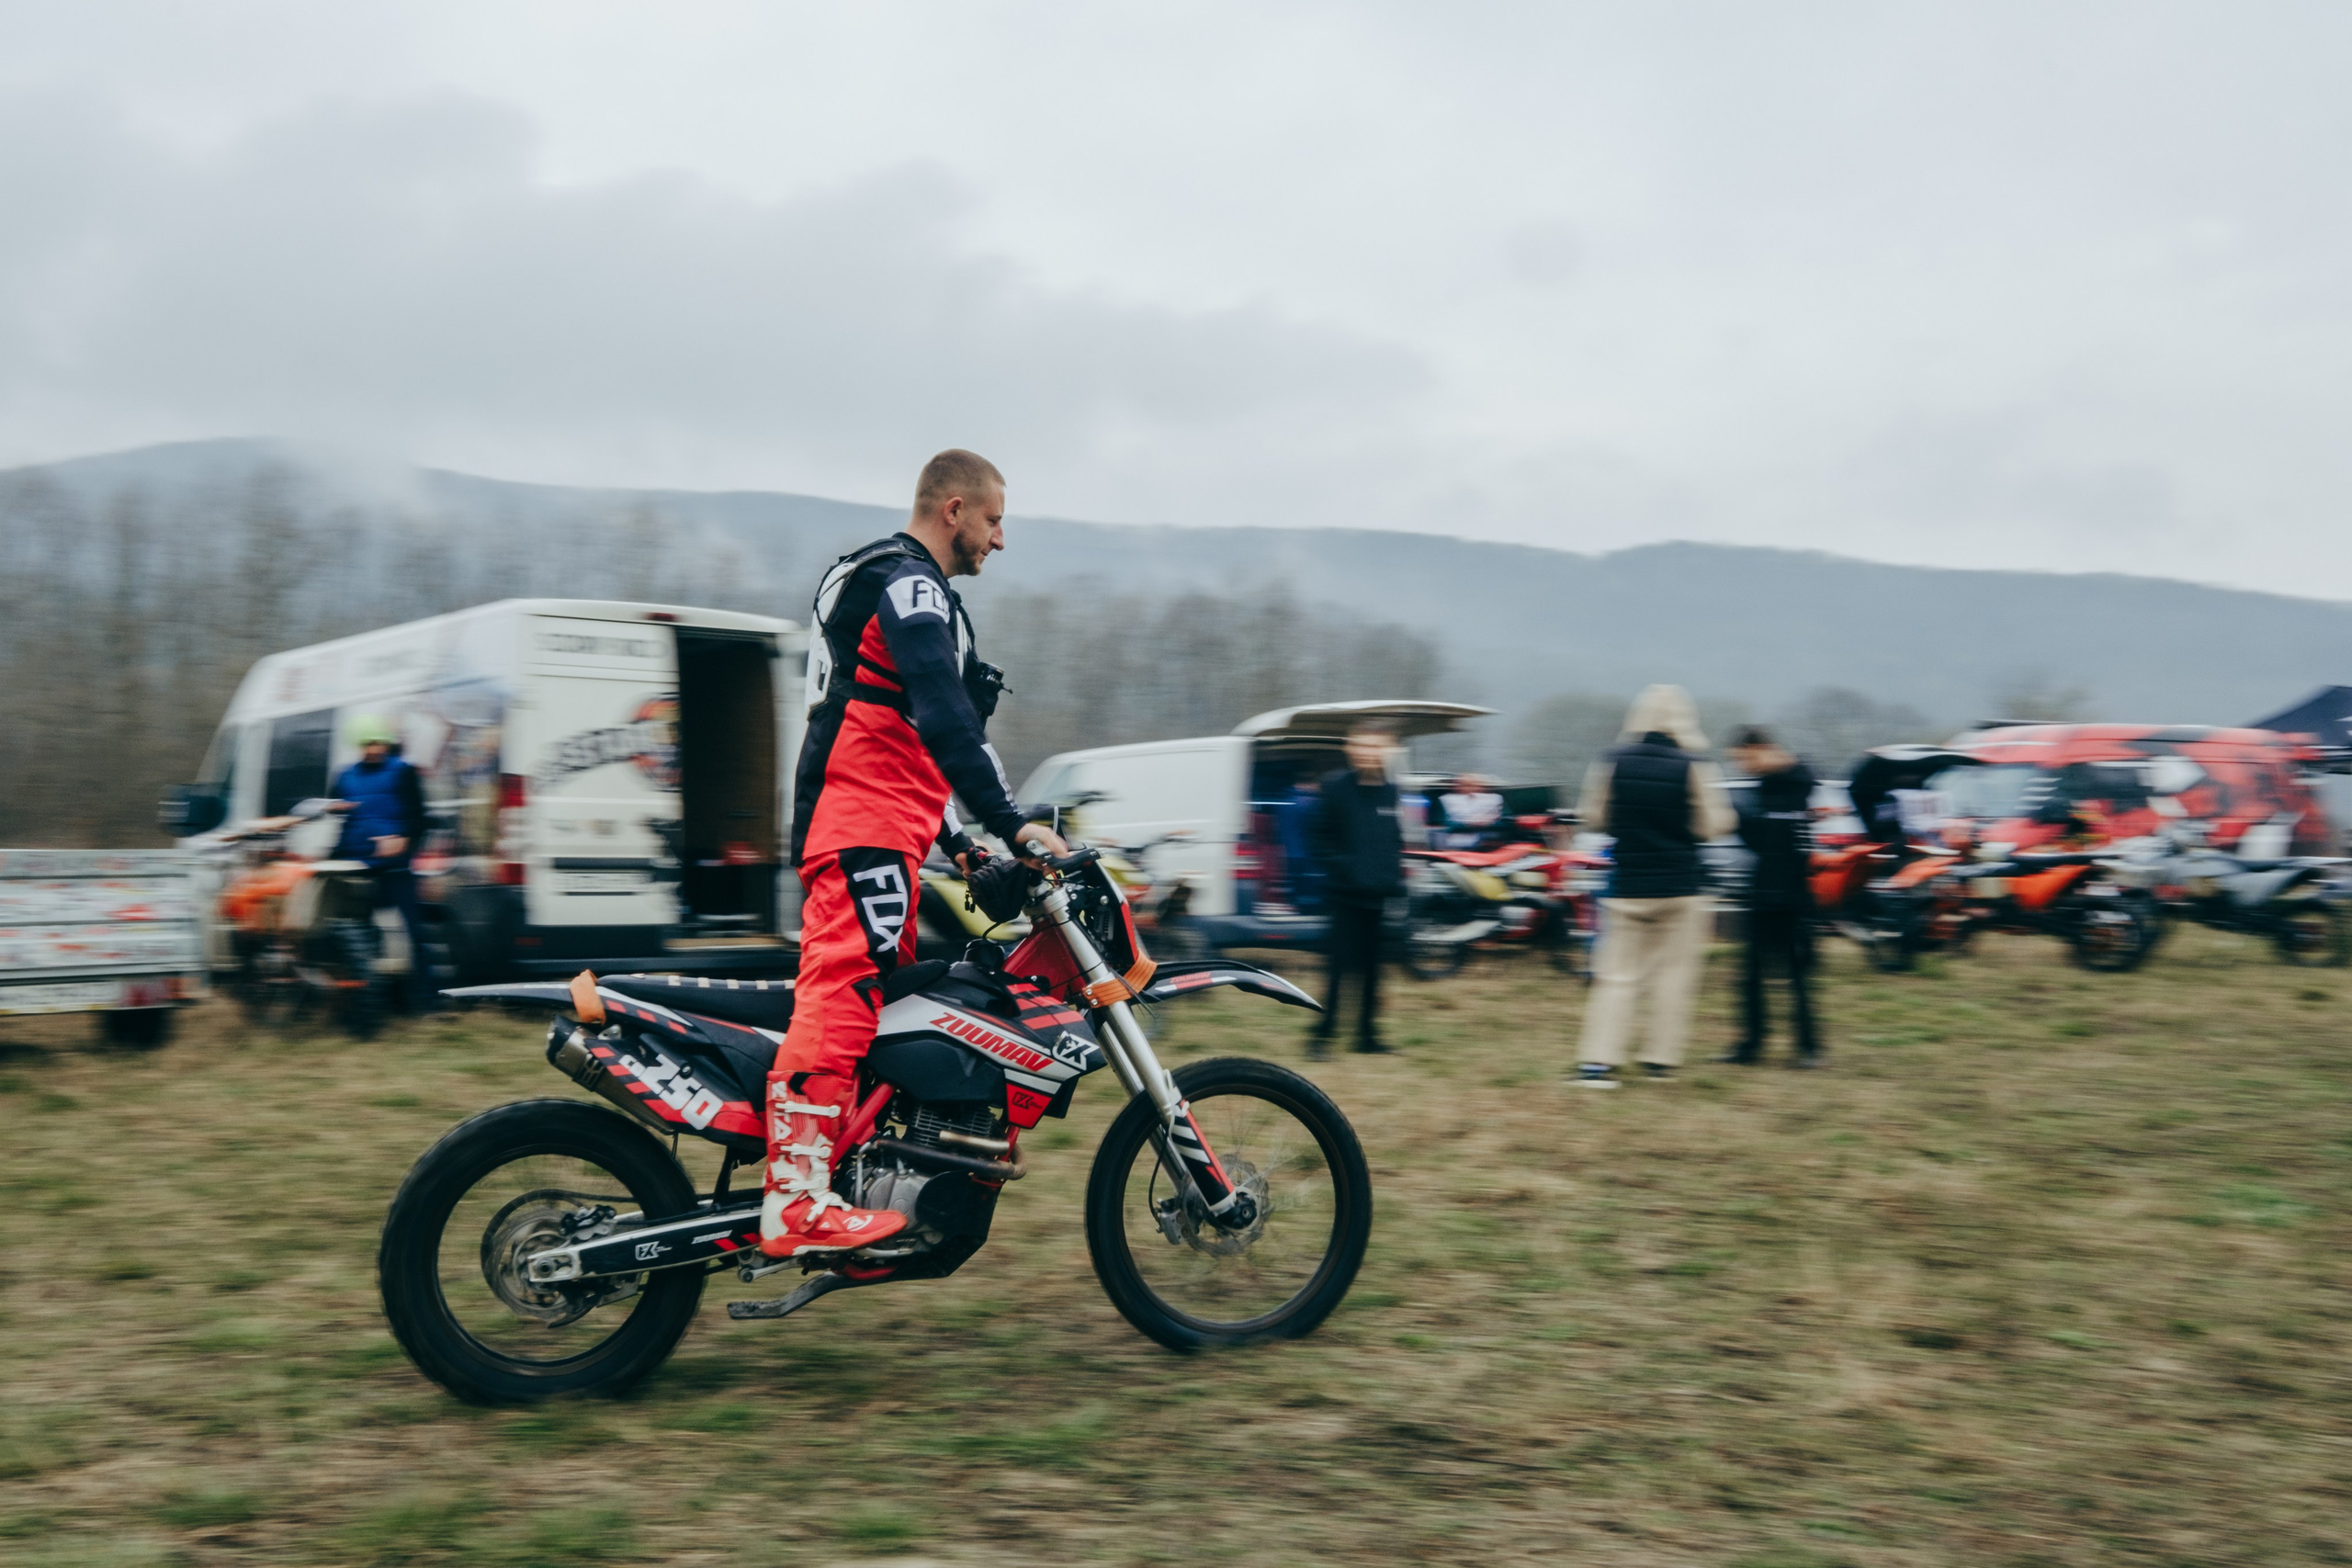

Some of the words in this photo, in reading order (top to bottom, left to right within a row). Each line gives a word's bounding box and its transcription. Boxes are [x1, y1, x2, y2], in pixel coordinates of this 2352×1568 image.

[912, 579, 949, 615] FO
[853, 864, 909, 953] FOX
[930, 1012, 1055, 1072] ZUUMAV
